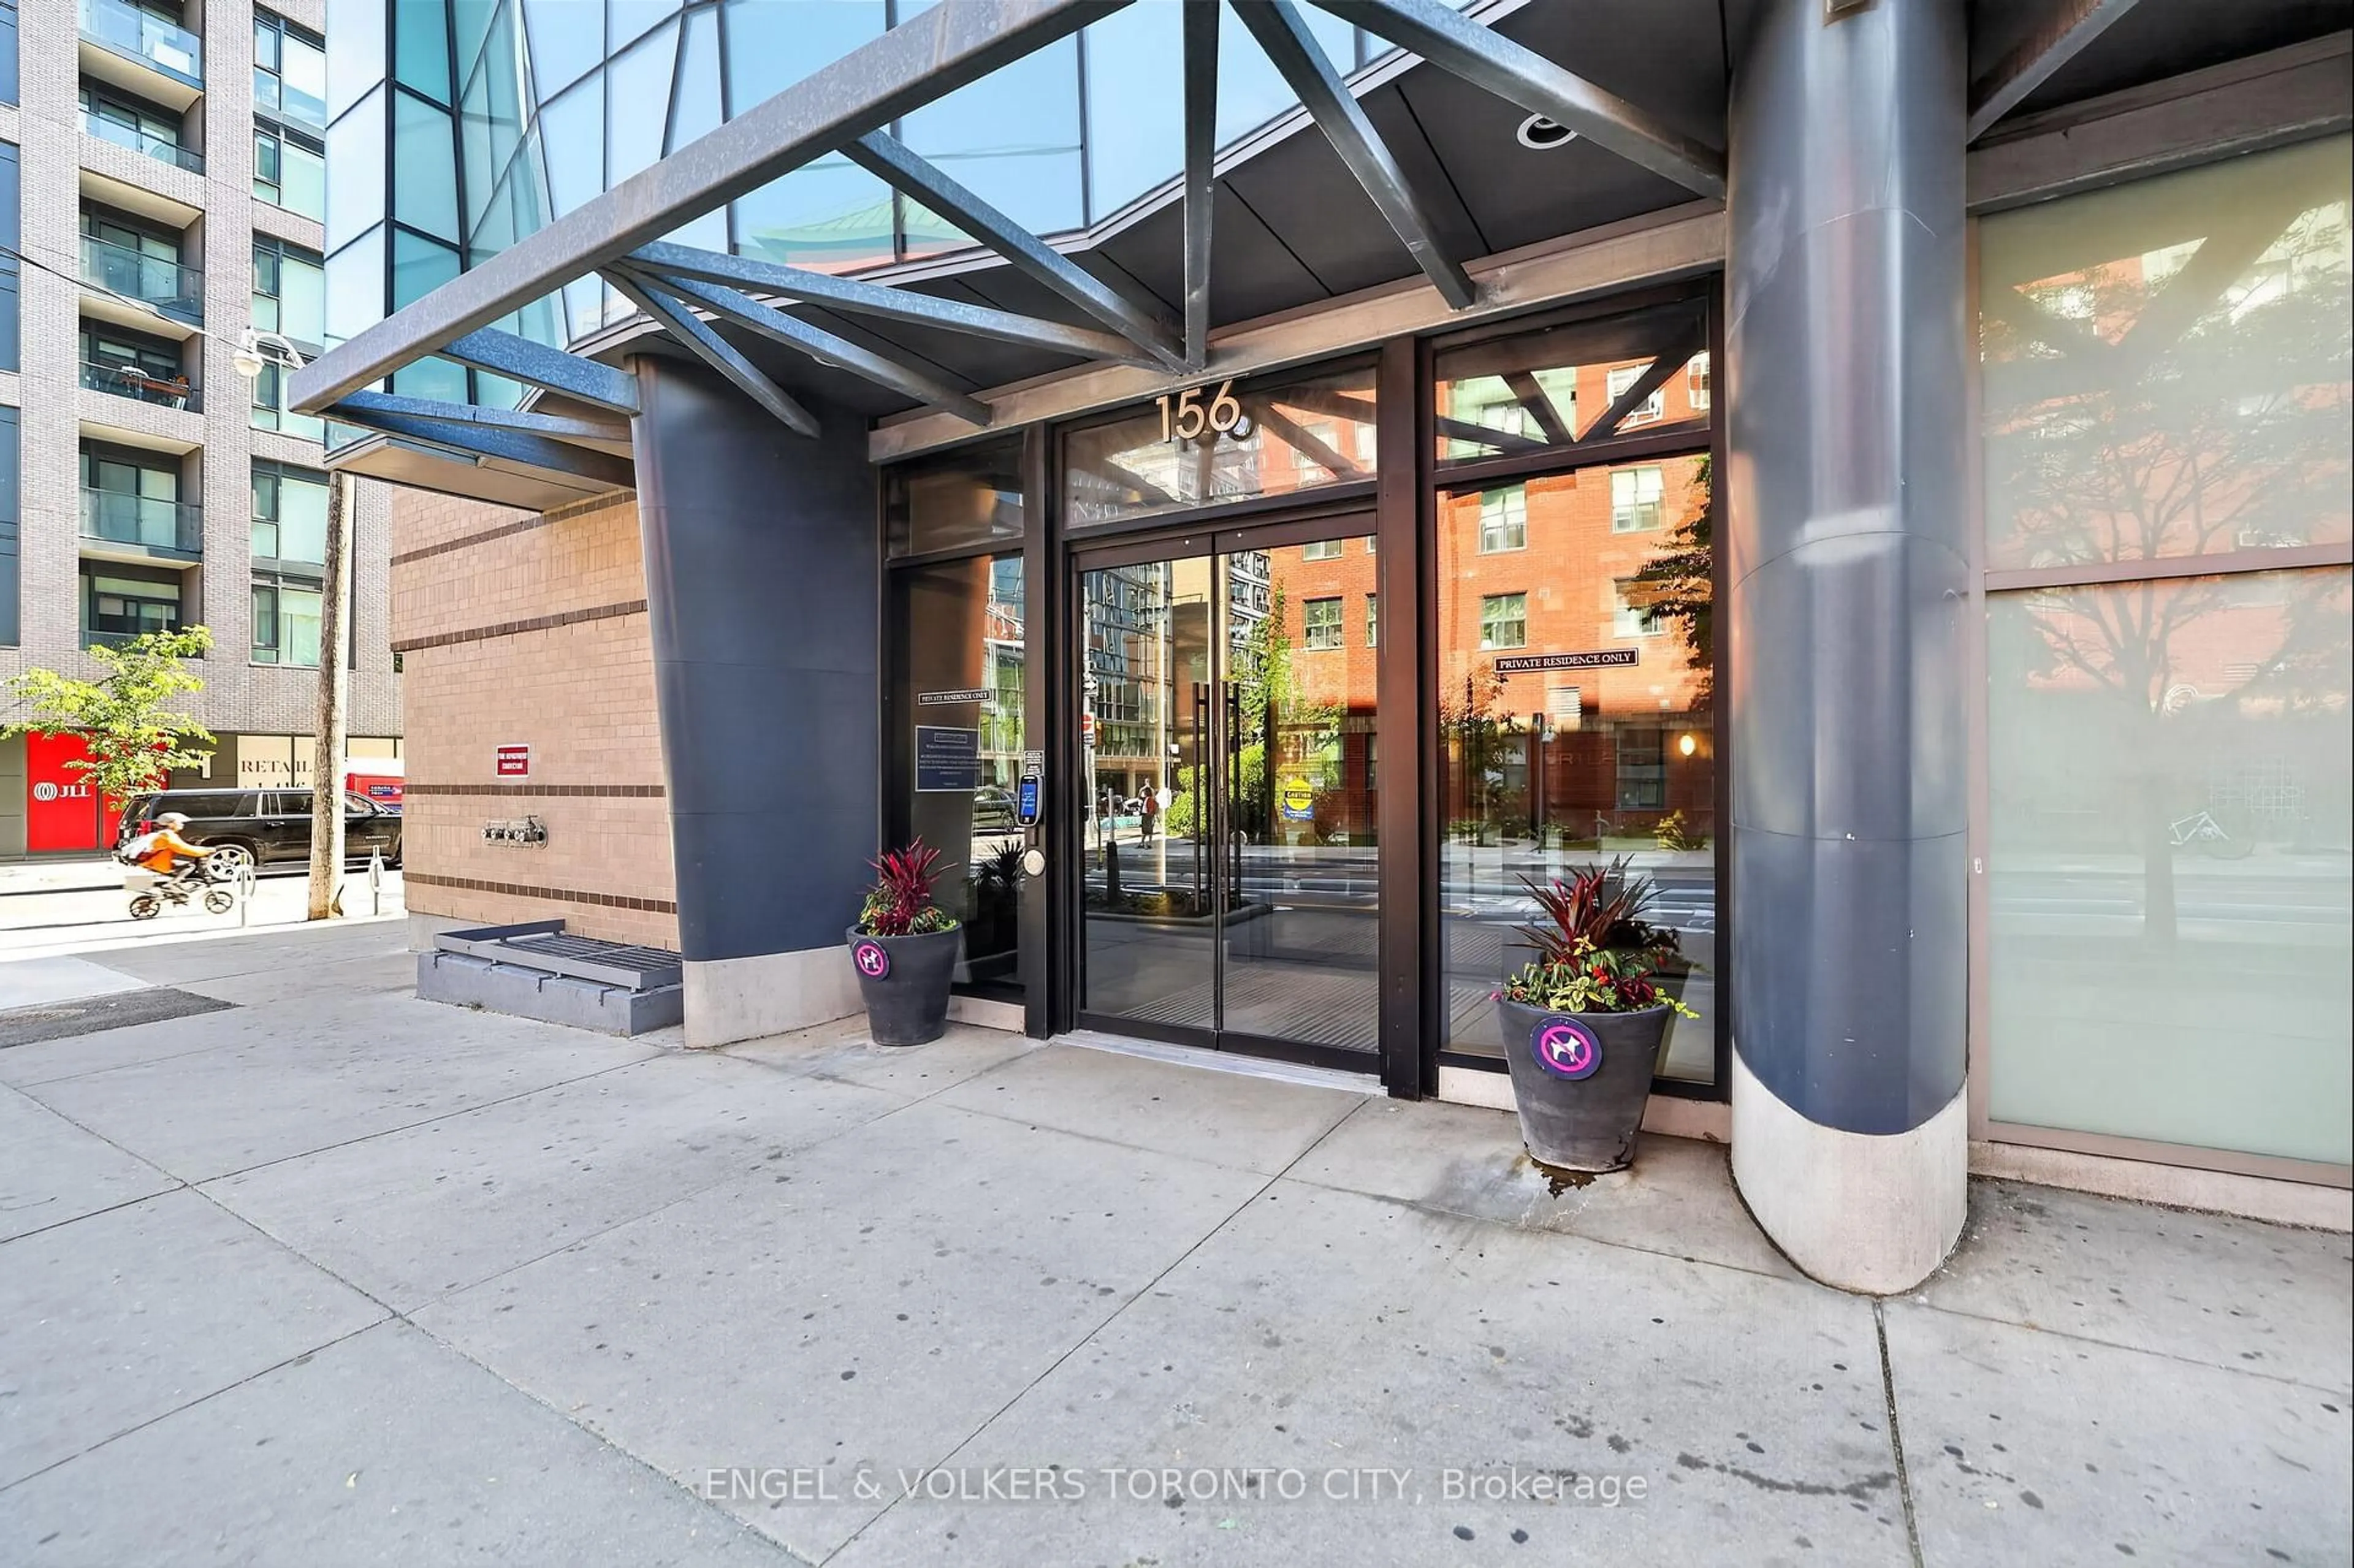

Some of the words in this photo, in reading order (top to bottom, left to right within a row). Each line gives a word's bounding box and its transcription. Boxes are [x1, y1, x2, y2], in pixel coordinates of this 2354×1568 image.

[1156, 378, 1241, 443] 156
[1499, 658, 1541, 669] PRIVATE
[1543, 655, 1599, 667] RESIDENCE
[1602, 652, 1631, 663] ONLY
[242, 760, 313, 772] RETAIL
[59, 785, 91, 797] JLL
